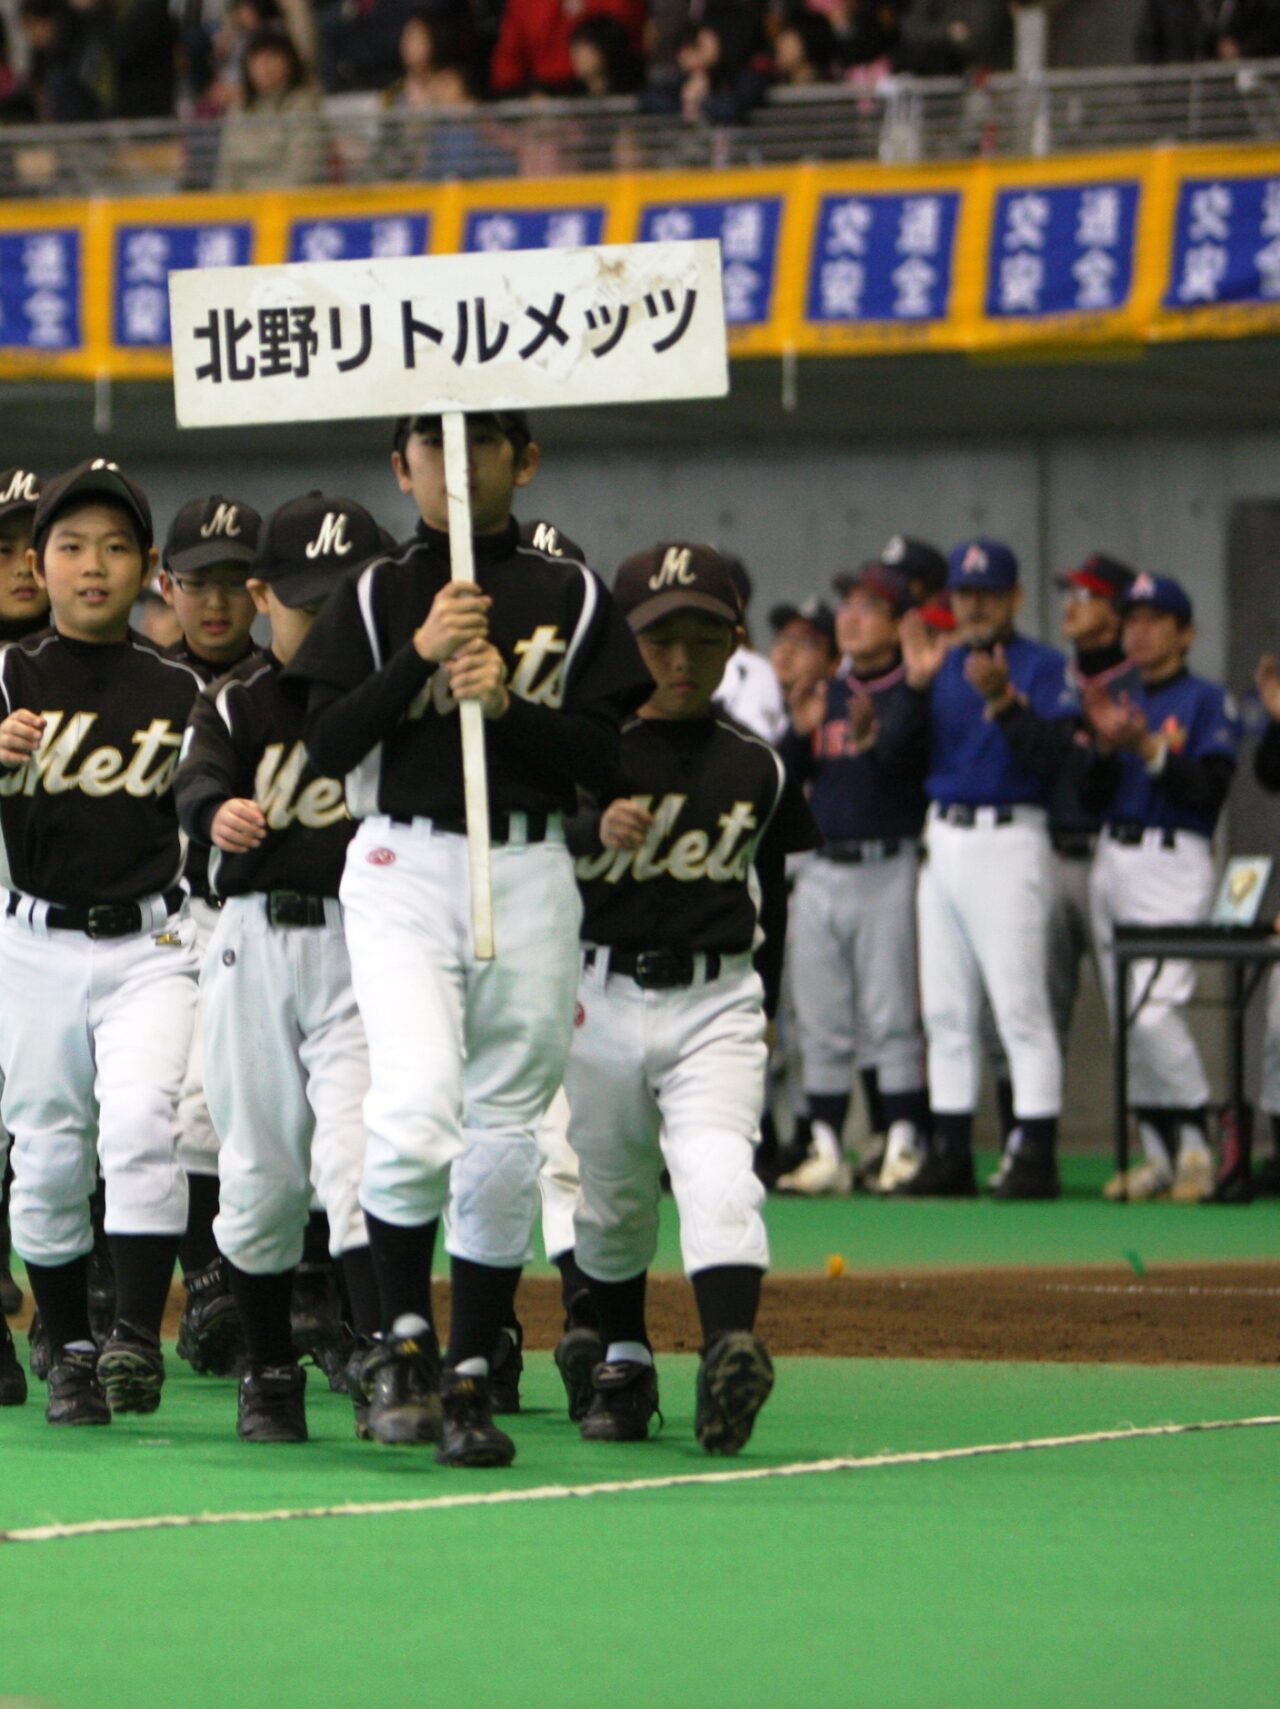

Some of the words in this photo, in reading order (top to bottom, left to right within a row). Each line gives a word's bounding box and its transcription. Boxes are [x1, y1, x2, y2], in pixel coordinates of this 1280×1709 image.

[193, 288, 697, 384] 北野リトルメッツ
[201, 503, 241, 538] M
[306, 512, 353, 559] M
[532, 522, 563, 557] M
[649, 547, 697, 591] M
[576, 793, 757, 884] Met
